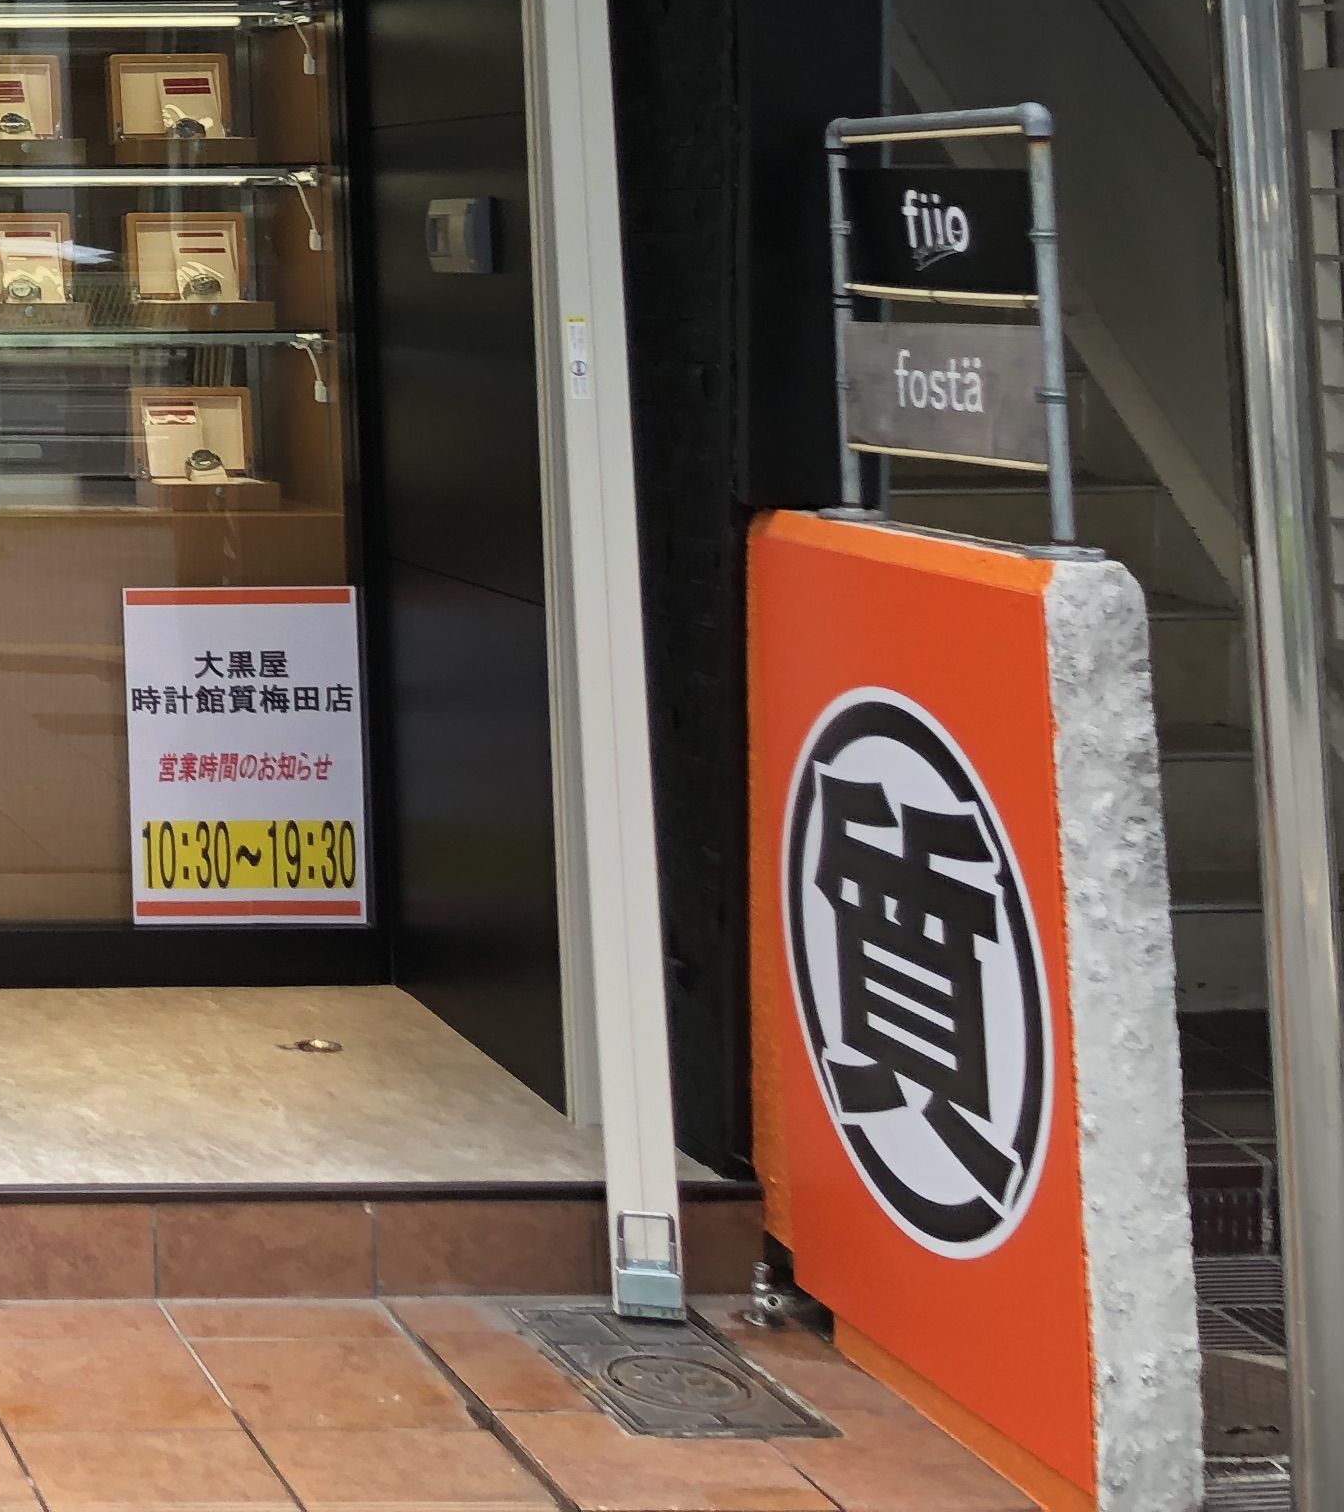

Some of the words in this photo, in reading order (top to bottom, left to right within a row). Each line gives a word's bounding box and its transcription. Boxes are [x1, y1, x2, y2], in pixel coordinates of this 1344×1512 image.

[894, 348, 984, 414] fostä
[193, 649, 290, 680] 大黒屋
[131, 684, 354, 716] 時計館質梅田店
[158, 752, 333, 784] 営業時間のお知らせ
[814, 765, 1016, 1210] 質
